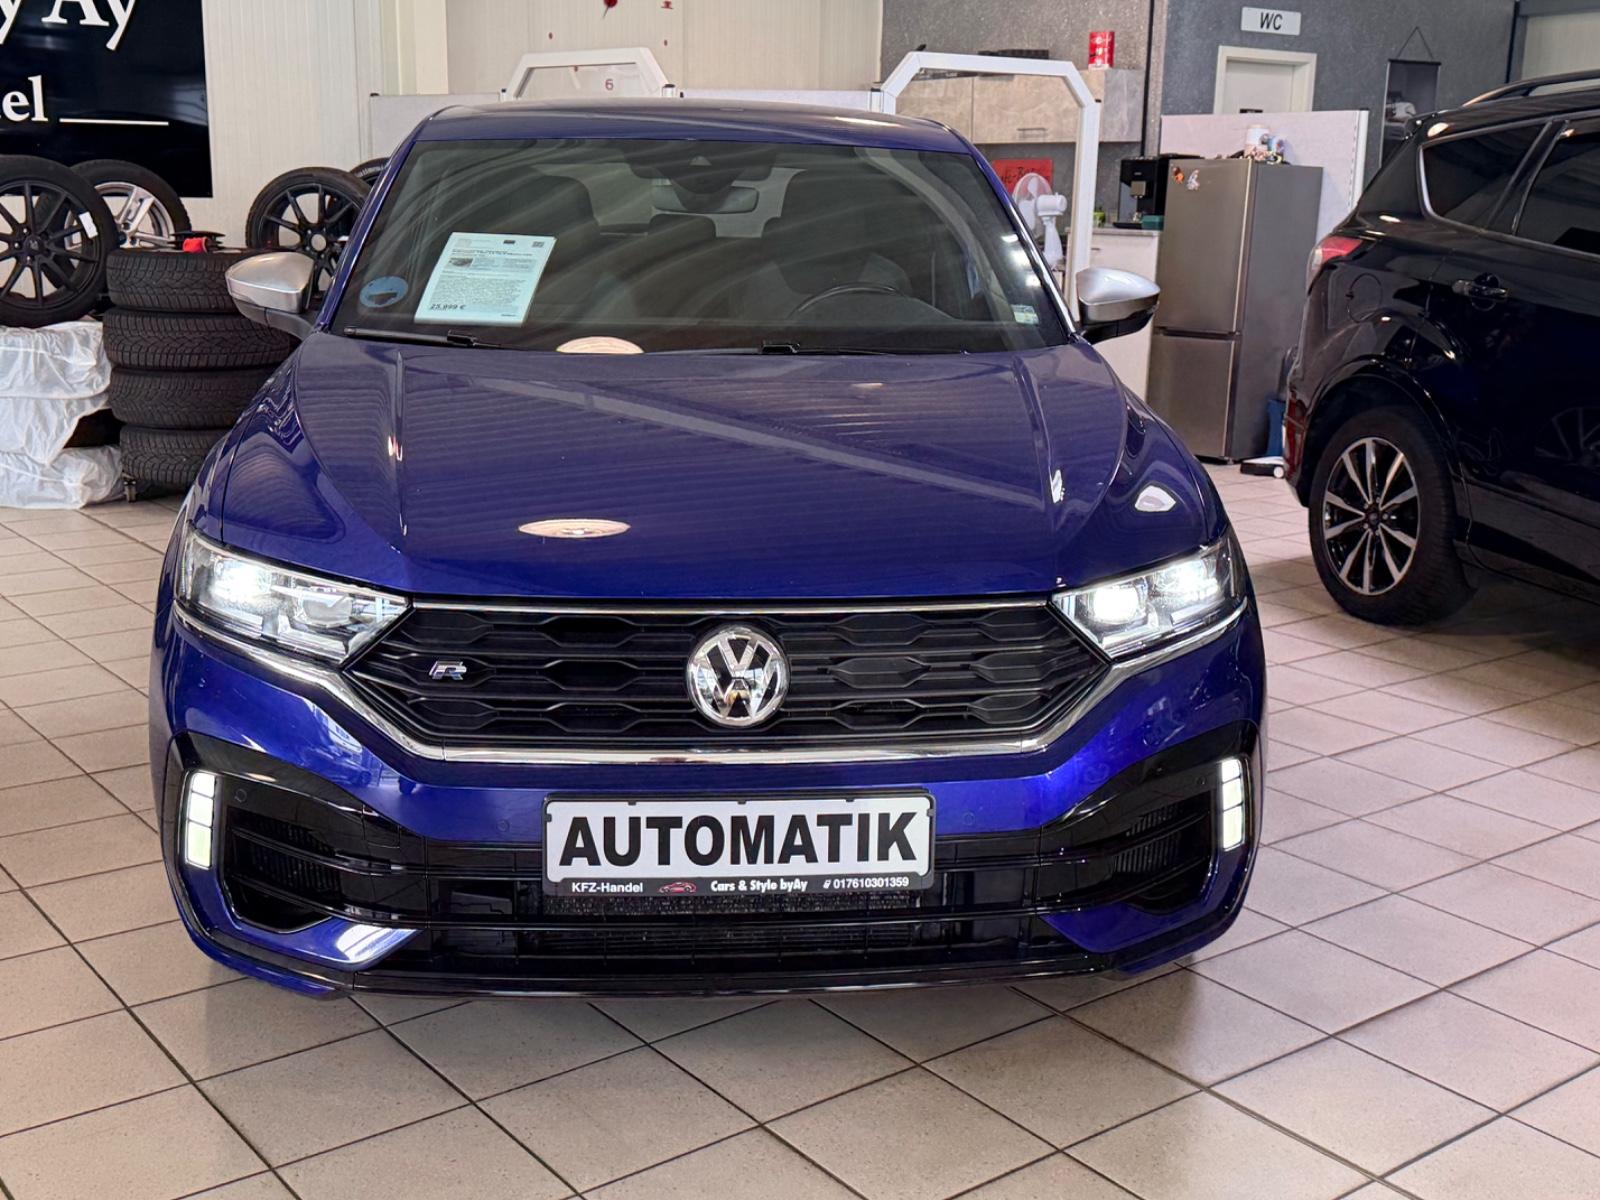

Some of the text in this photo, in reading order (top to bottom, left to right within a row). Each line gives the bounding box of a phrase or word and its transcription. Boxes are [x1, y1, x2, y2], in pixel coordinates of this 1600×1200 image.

[1260, 12, 1283, 31] WC
[605, 78, 614, 91] 6
[0, 75, 49, 122] el
[559, 811, 917, 867] AUTOMATIK
[571, 876, 910, 893] KFZ-Handel Cars & Style byAy 017610301359
